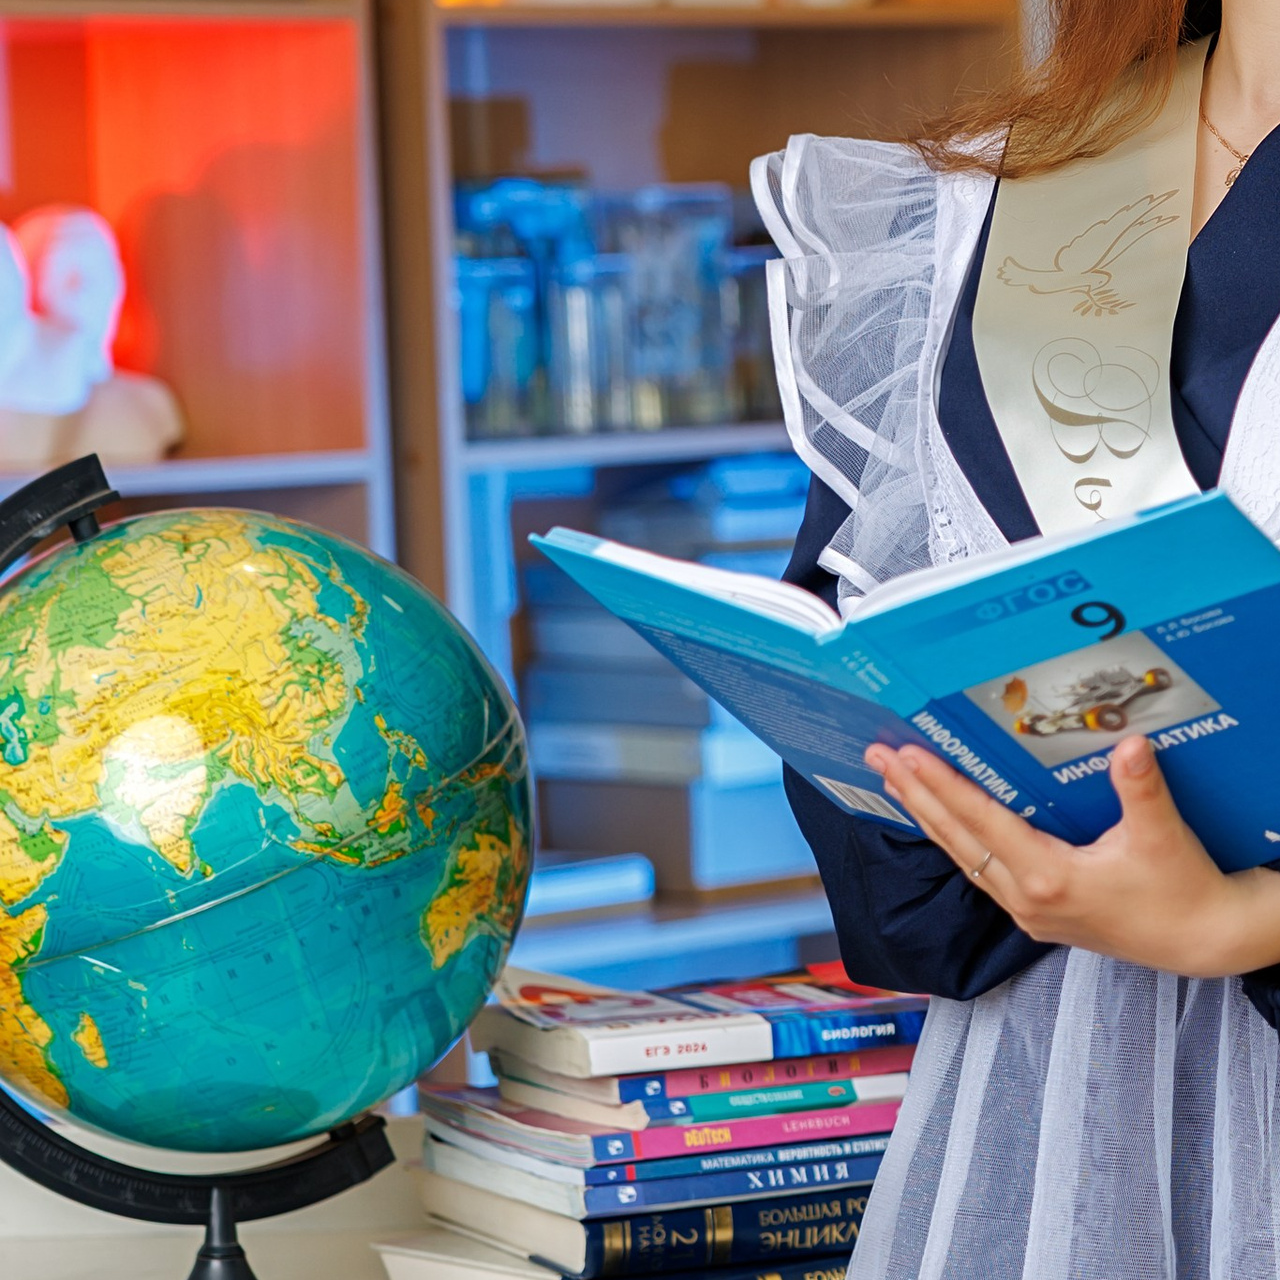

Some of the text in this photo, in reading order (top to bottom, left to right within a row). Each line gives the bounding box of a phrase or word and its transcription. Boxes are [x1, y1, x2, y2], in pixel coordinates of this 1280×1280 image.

[975, 572, 1086, 620] ФГОС
[1071, 601, 1127, 641] 9
[911, 711, 1037, 818] ИНФОРМАТИКА 9
[1053, 713, 1239, 785] ИНФАТИКА
[821, 1023, 896, 1041] БИОЛОГИЯ
[645, 1045, 671, 1058] ЕГЭ
[699, 1055, 861, 1089] БИОЛОГИЯ
[729, 1089, 804, 1107] ОБЩЕСТВОЗНАНИЕ
[684, 1115, 851, 1147] DEUTSCH LEHRBUCH
[777, 1143, 843, 1162] ВЕРОЯТНОСТЬ
[852, 1138, 890, 1154] СТАТИС
[747, 1161, 850, 1189] ХИМИЯ
[759, 1200, 841, 1227] БОЛЬШАЯ
[759, 1221, 860, 1252] ЭНЦИКЛ
